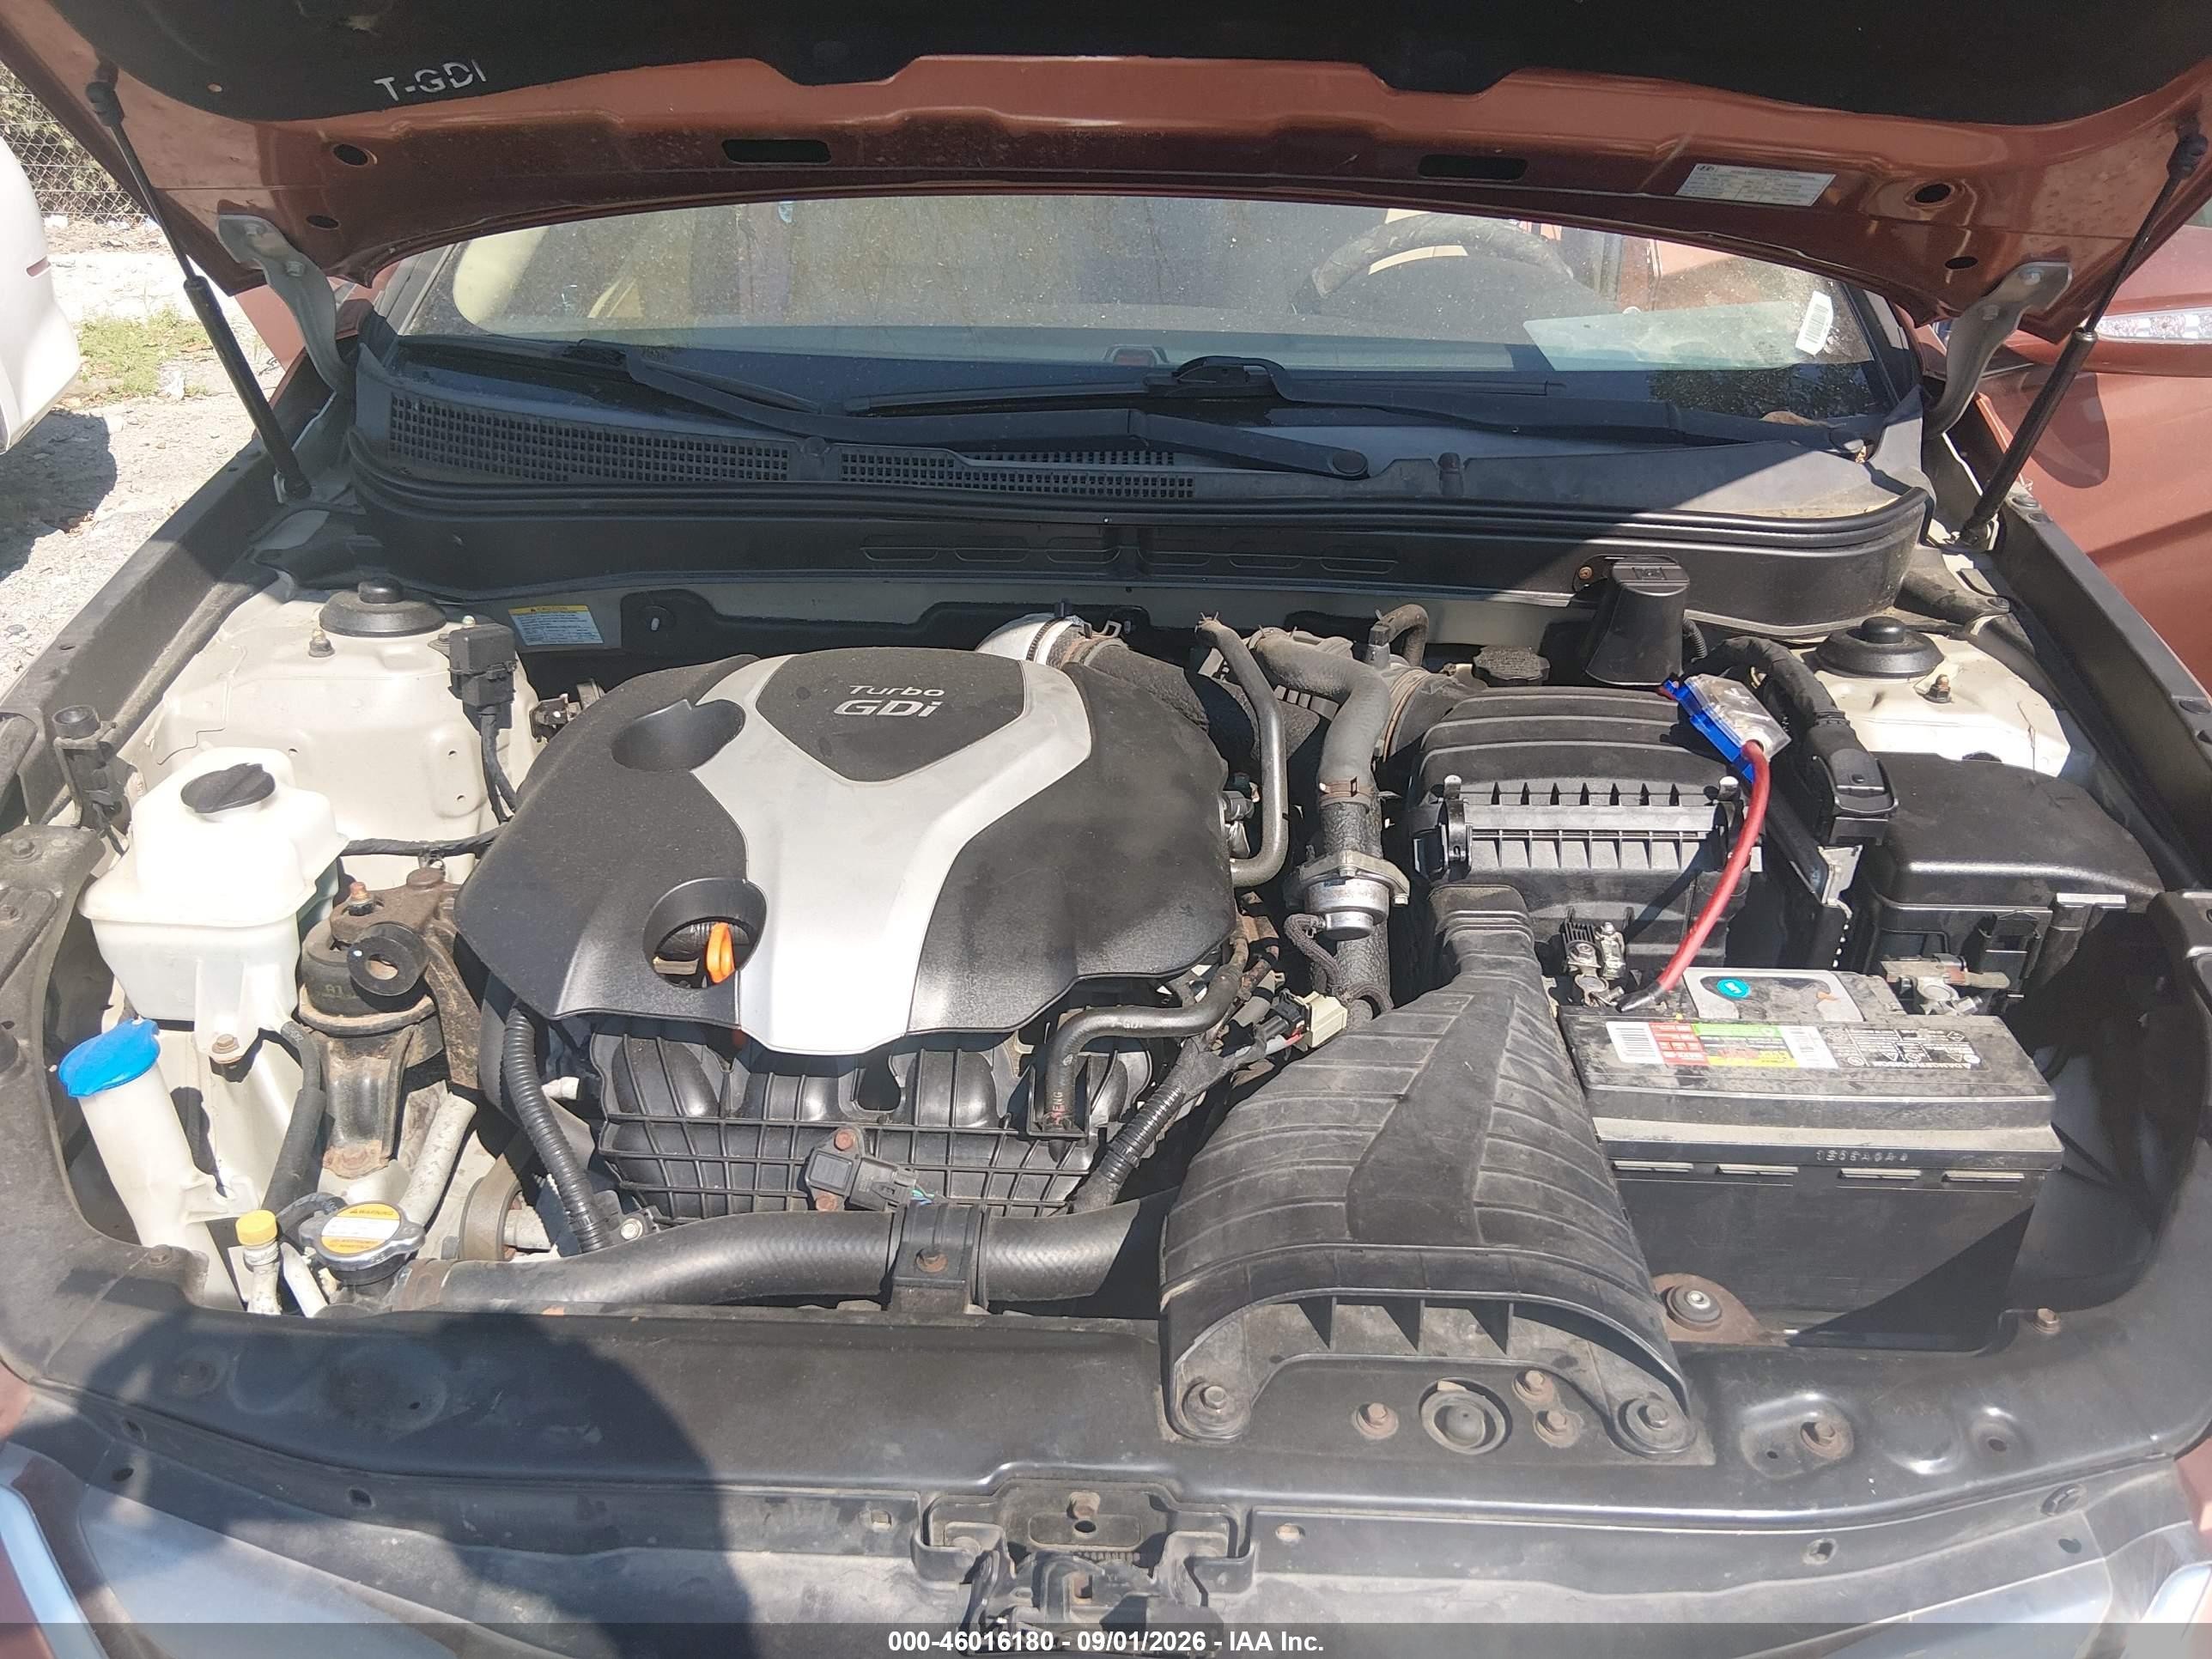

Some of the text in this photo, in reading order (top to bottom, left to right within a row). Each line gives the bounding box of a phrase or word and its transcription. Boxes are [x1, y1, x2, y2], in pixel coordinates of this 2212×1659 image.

[374, 59, 487, 101] T-GDI
[848, 684, 945, 696] Turbo
[833, 699, 943, 717] GDi
